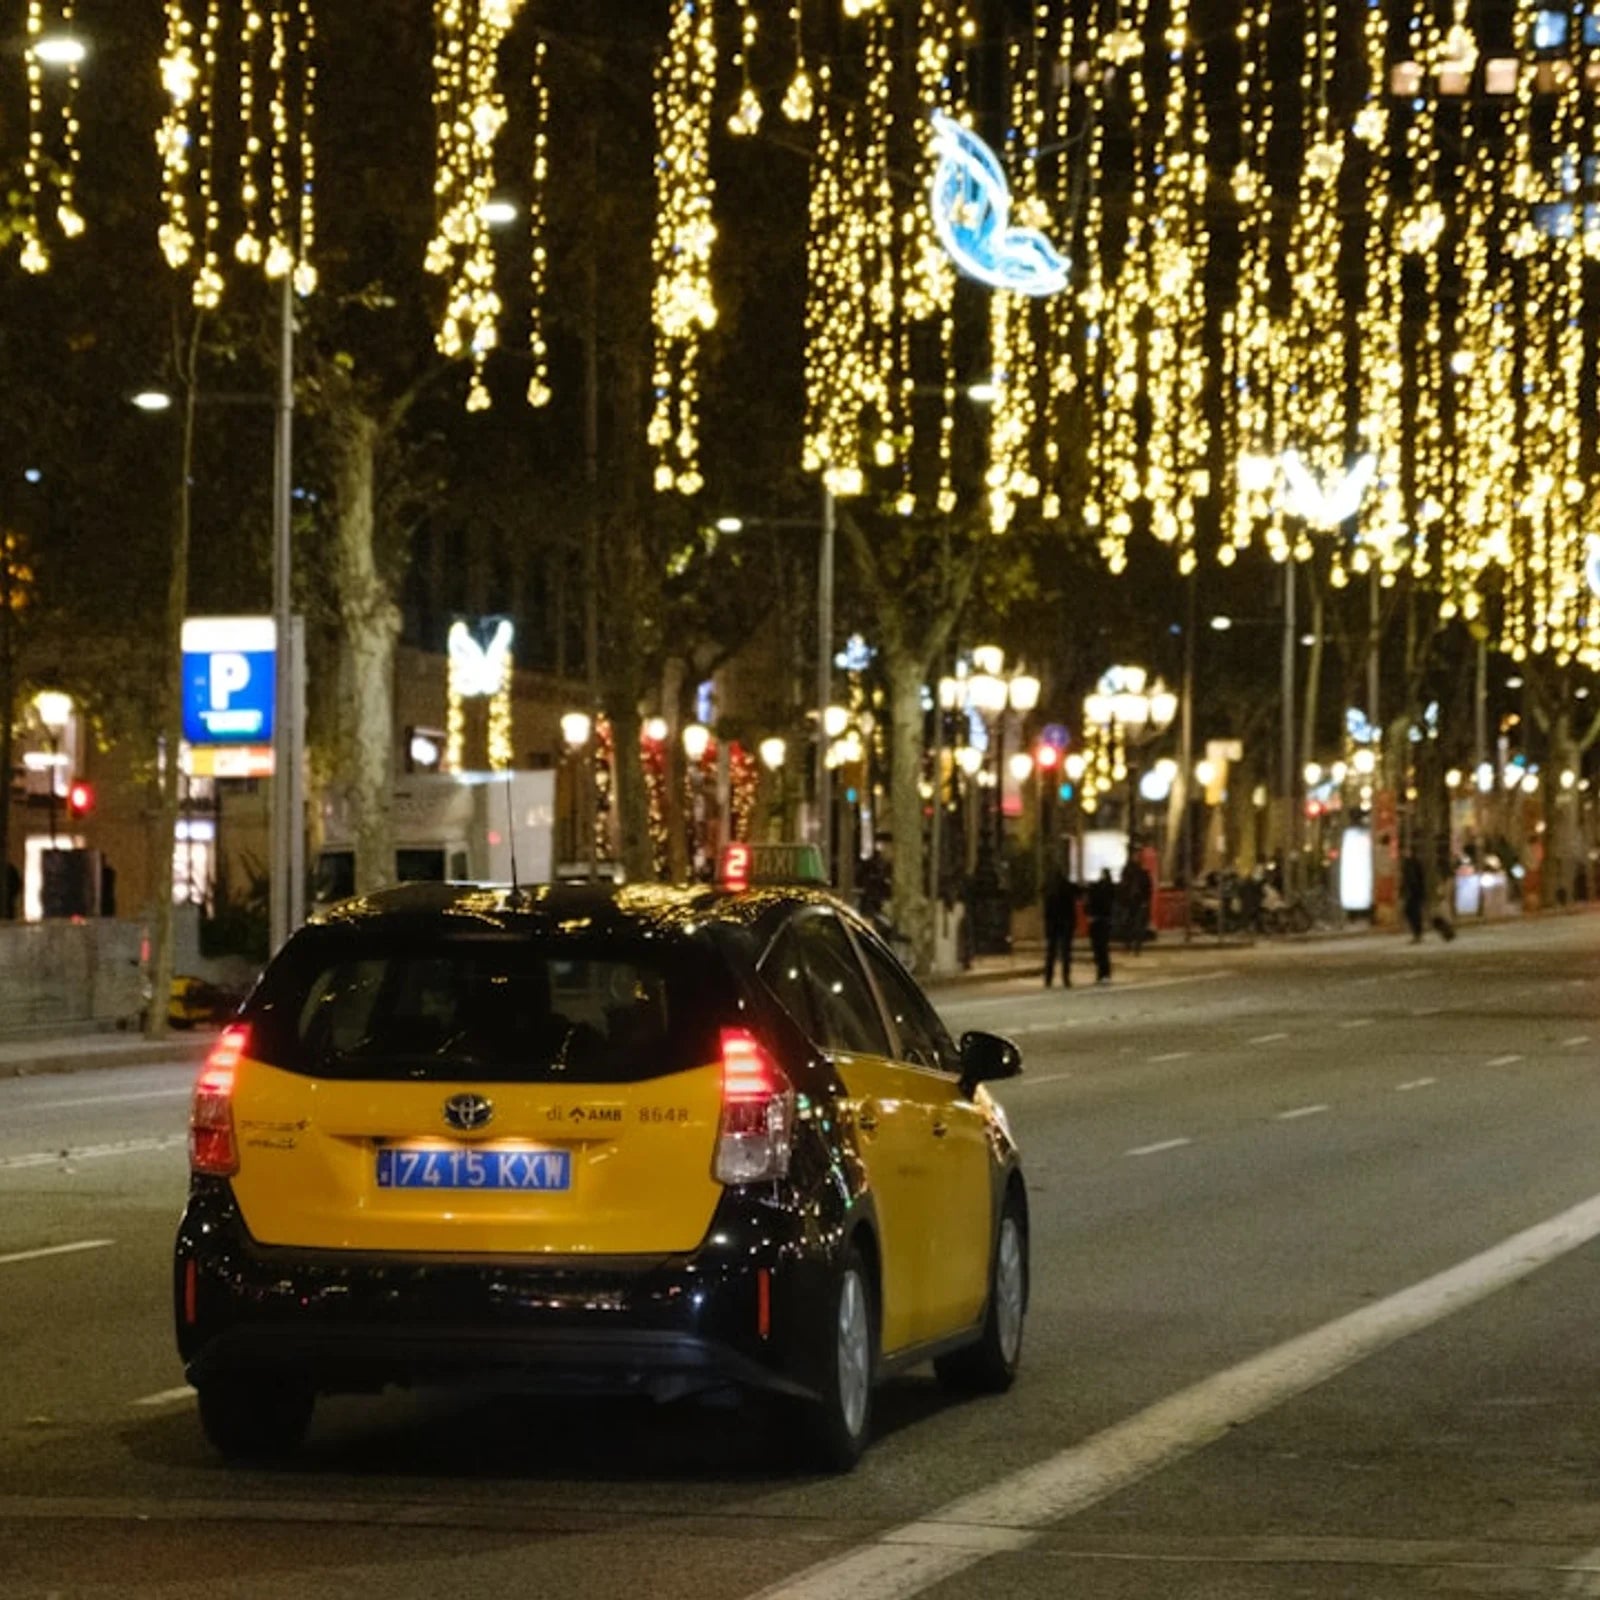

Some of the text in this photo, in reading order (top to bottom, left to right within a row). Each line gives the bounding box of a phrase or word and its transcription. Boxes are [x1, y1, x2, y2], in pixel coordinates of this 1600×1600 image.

[210, 653, 251, 711] P
[726, 847, 748, 878] 2
[753, 848, 794, 876] TAXI
[588, 1108, 622, 1121] AMB
[400, 1151, 563, 1187] 7415 KXW
